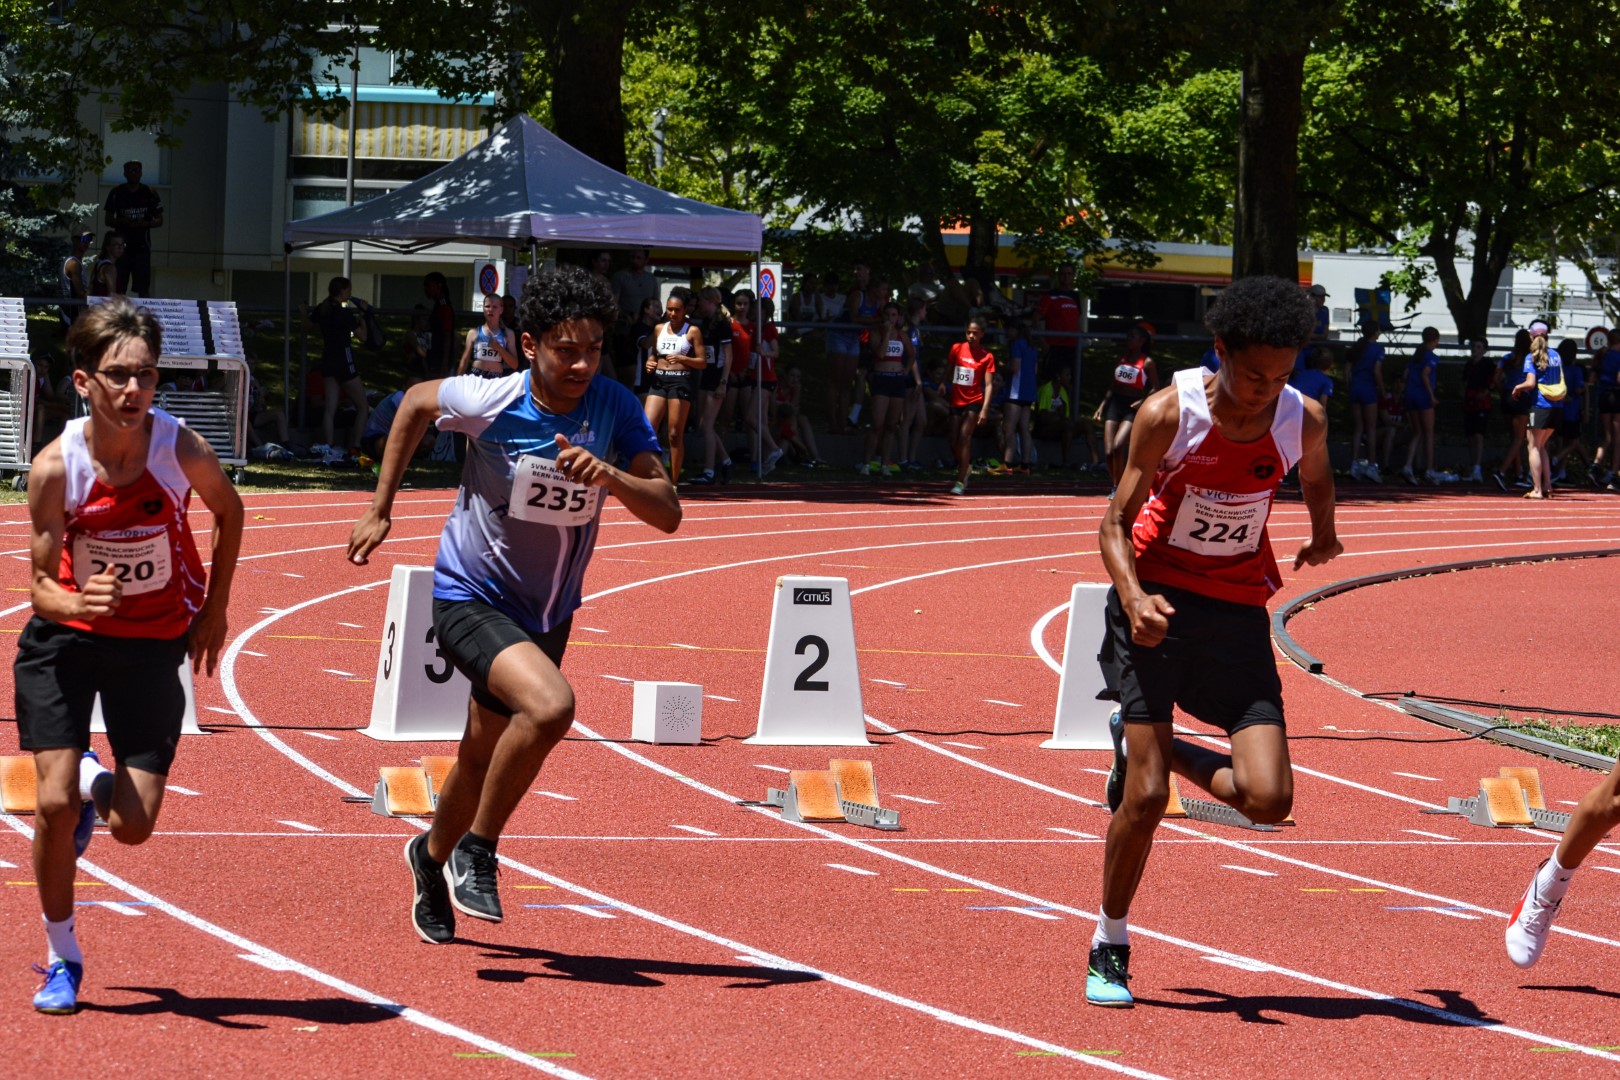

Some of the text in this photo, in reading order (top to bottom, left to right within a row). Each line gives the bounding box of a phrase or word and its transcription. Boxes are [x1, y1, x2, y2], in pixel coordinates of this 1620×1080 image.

[481, 348, 498, 357] 367
[661, 342, 676, 350] 321
[1117, 370, 1132, 380] 306
[527, 483, 588, 512] 235
[1188, 518, 1249, 543] 224
[91, 559, 155, 583] 220
[384, 621, 396, 680] 3
[424, 625, 455, 684] 3
[793, 634, 830, 692] 2
